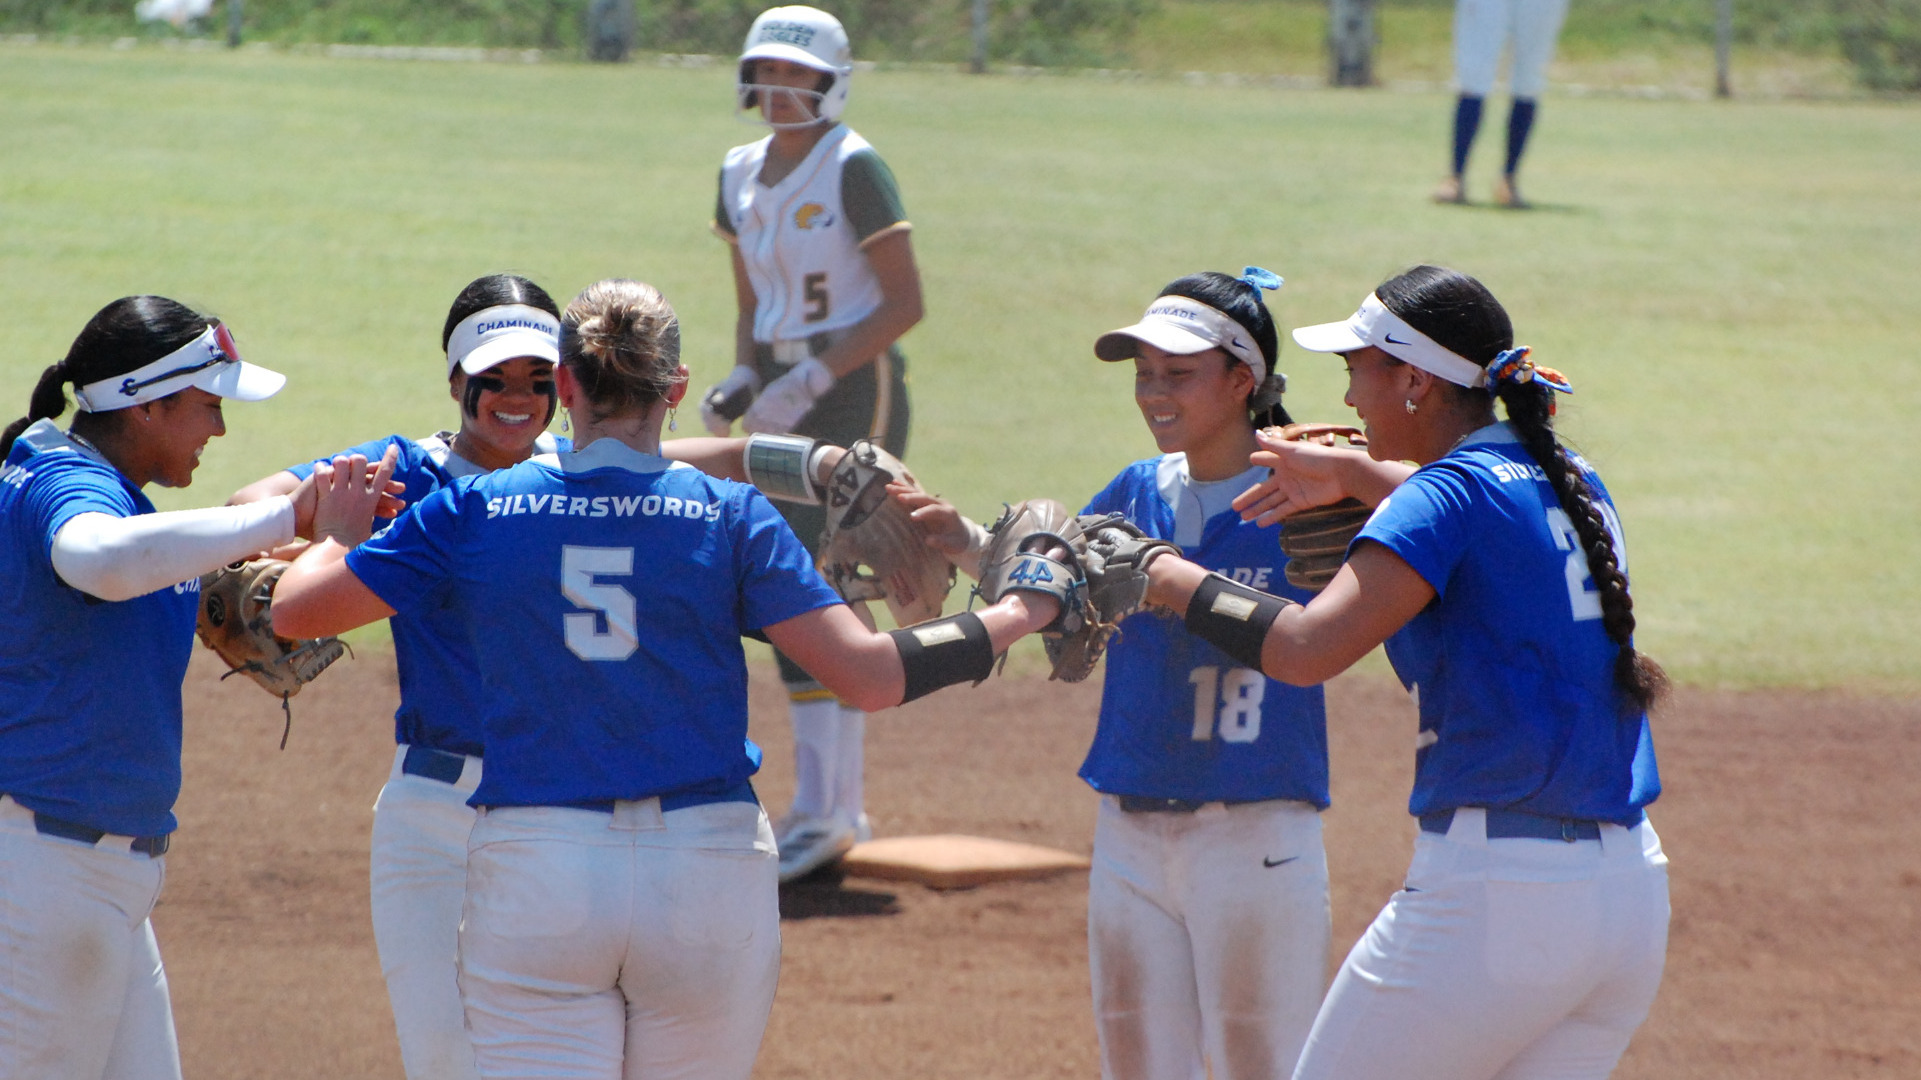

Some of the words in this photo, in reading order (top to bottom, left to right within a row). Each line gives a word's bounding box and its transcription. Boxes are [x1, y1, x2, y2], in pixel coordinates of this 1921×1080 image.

[803, 272, 828, 324] 5
[486, 493, 722, 522] SILVERSWORDS
[561, 544, 639, 662] 5
[1188, 665, 1266, 743] 18
